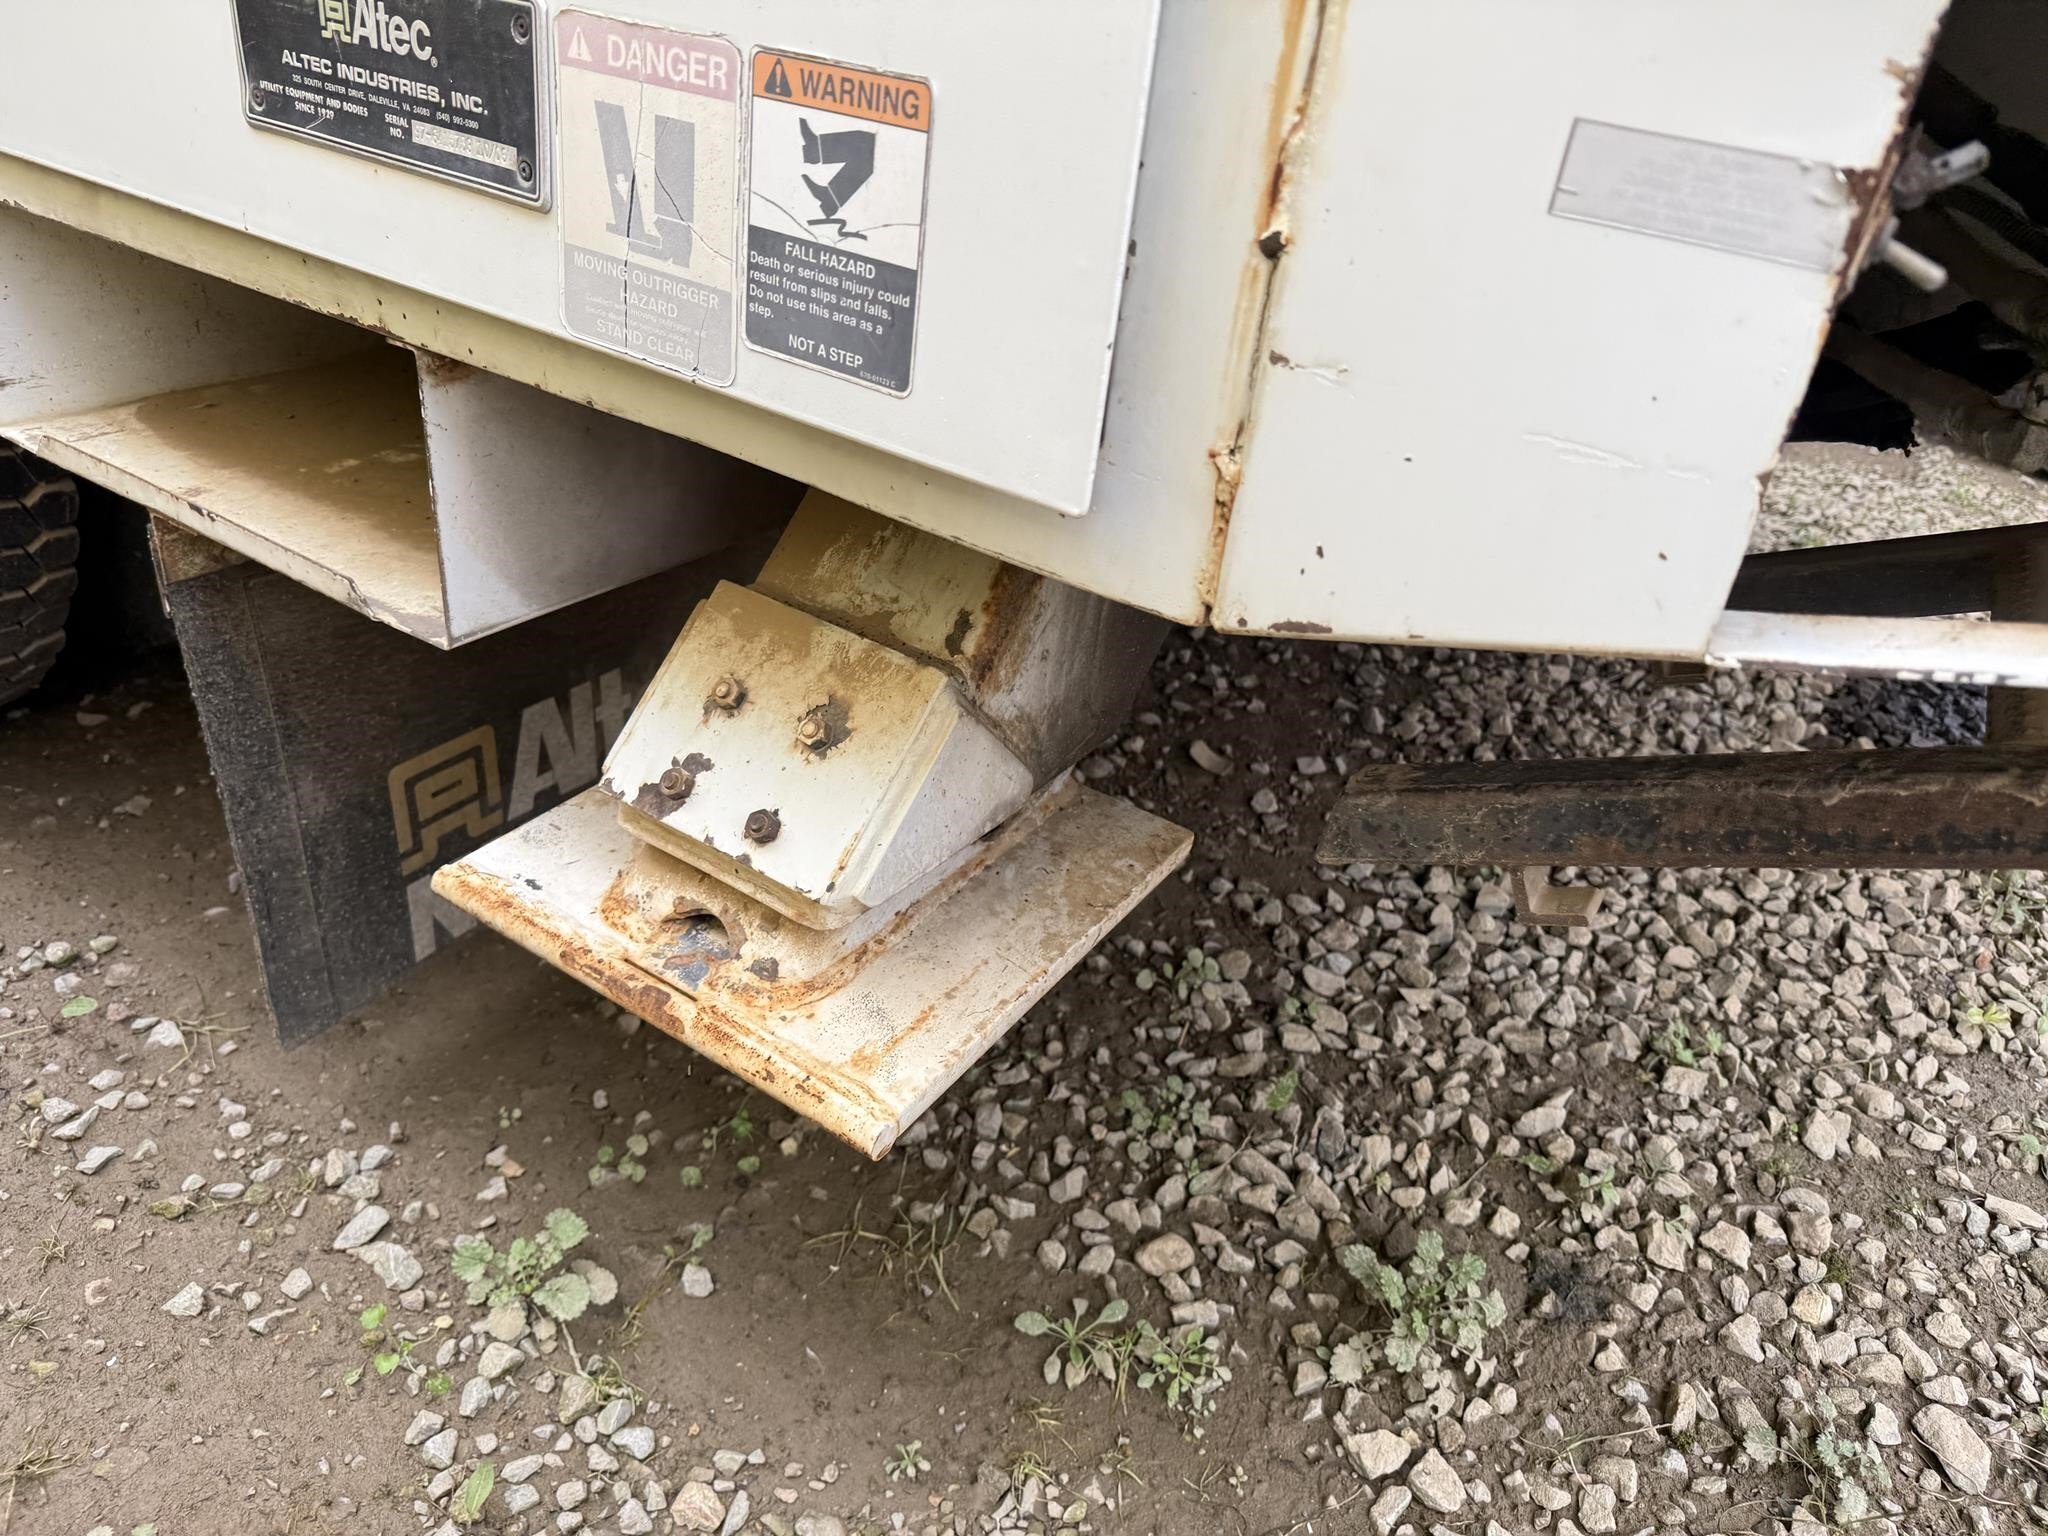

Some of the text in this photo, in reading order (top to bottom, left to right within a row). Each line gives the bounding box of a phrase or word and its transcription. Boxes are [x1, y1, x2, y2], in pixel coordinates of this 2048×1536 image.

[281, 49, 489, 116] ALTEC INDUSTRIES, INC.
[607, 34, 728, 90] DANGER
[259, 80, 368, 117] UTILITY EQUIPMENT AND BODIES
[294, 101, 335, 120] SINCE 1929
[304, 77, 322, 88] SOUTH
[324, 82, 346, 94] CENTER
[348, 88, 367, 100] DRIVE,
[368, 94, 400, 110] DALEVILLE,
[402, 102, 411, 112] VA
[436, 111, 450, 123] (540)
[799, 68, 920, 121] WARNING
[384, 113, 409, 128] SERIAL
[389, 127, 405, 140] NO.
[574, 251, 720, 310] MOVING OUTRIGGER
[750, 250, 910, 308] Death or serious injury could
[785, 241, 876, 279] FALL HAZARD
[620, 287, 678, 318] HAZARD
[748, 302, 775, 319] step.
[749, 270, 892, 321] result from slips and falls.
[749, 284, 883, 335] Do not use this area as a
[596, 319, 643, 345] STAND
[647, 336, 695, 362] CLEAR
[788, 334, 863, 368] NOT A STEP
